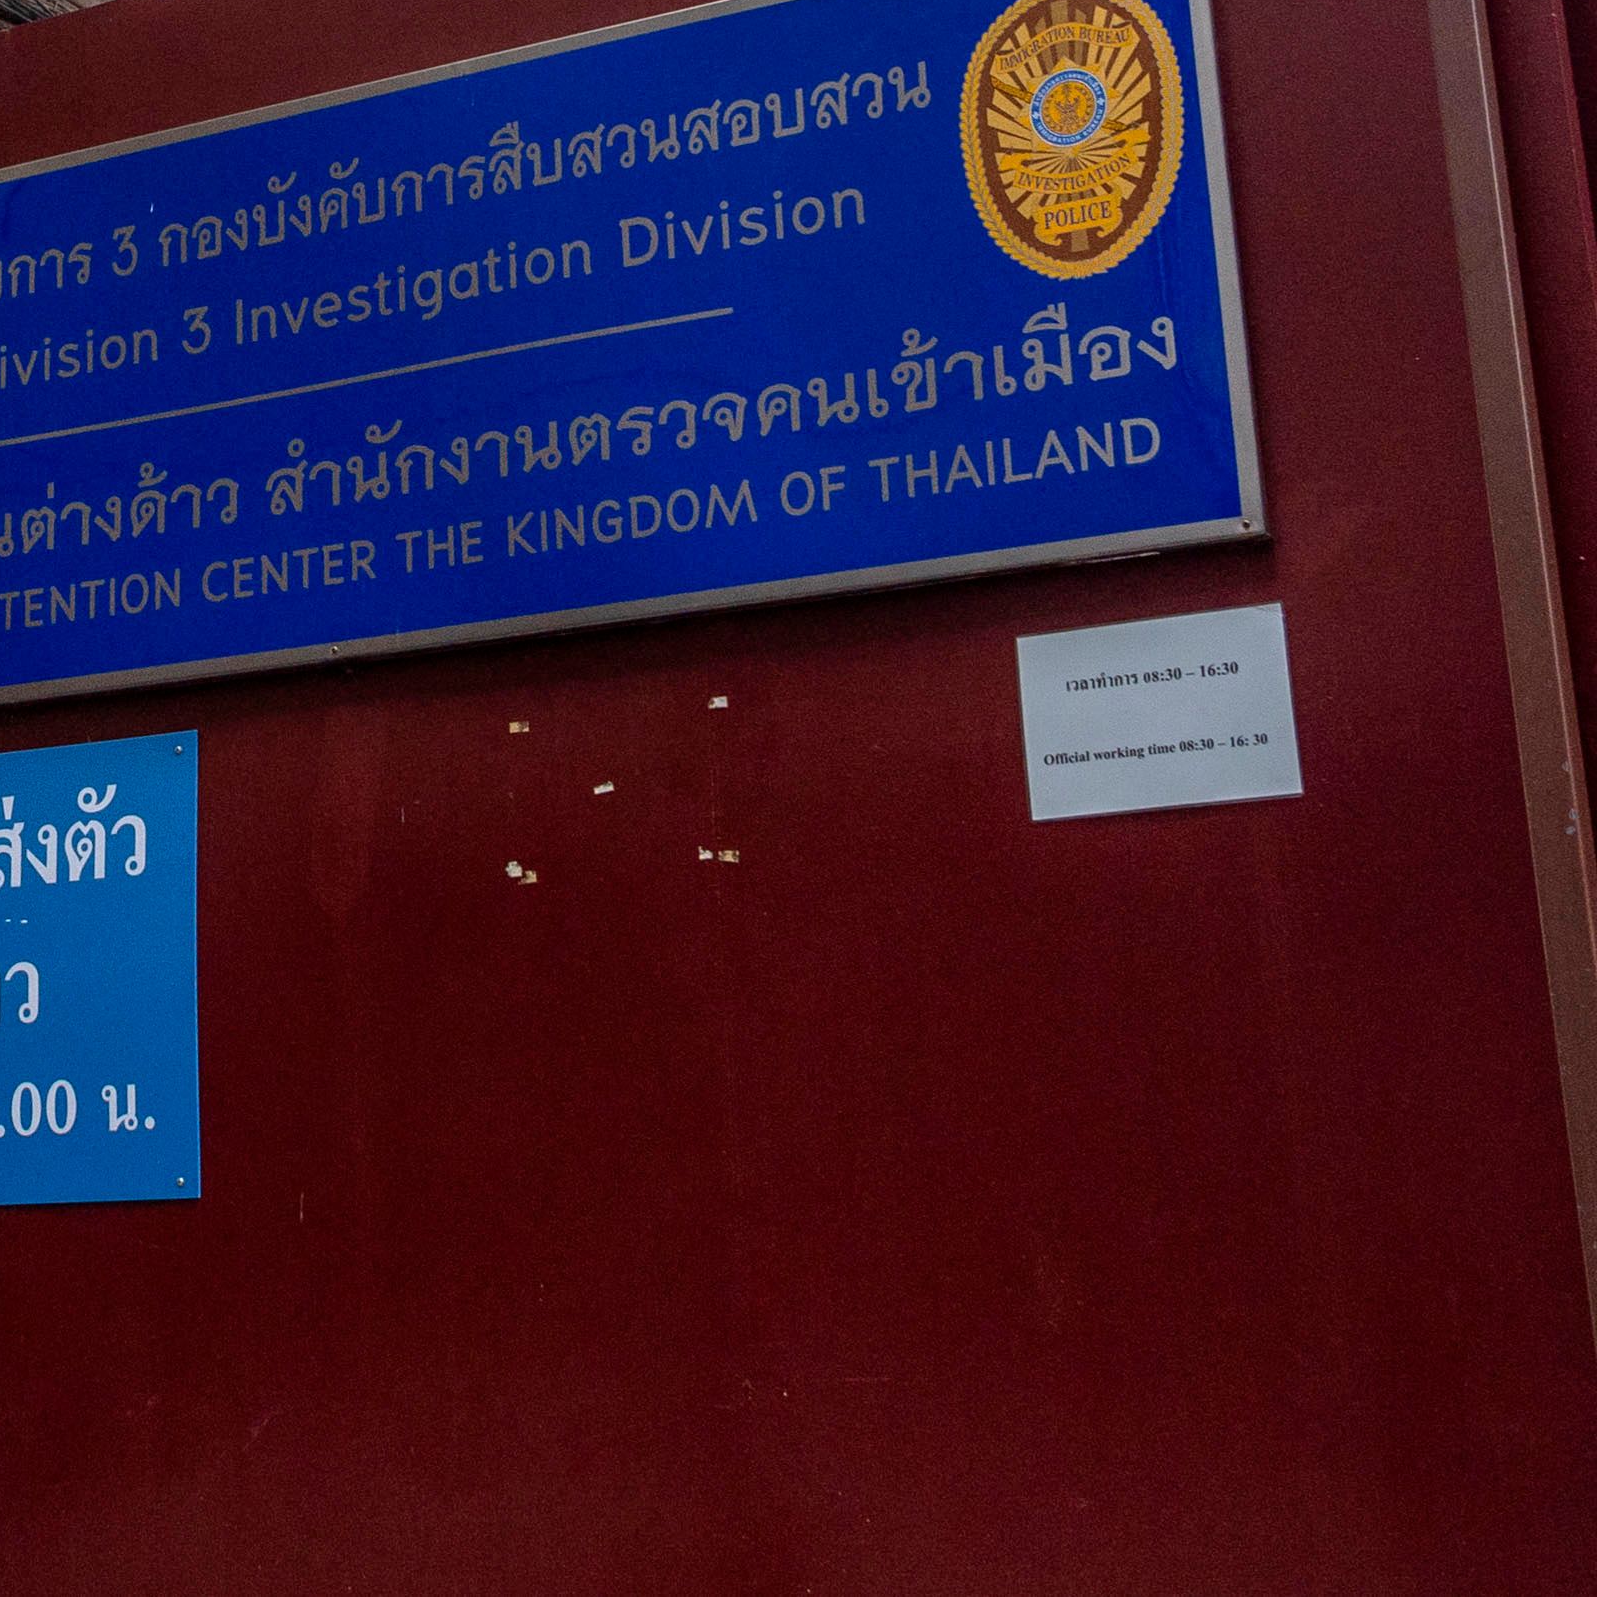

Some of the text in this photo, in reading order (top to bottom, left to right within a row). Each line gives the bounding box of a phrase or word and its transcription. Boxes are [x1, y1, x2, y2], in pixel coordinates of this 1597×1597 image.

[999, 25, 1132, 71] IMMIGRATION BUREAU
[111, 225, 139, 277] 3
[159, 61, 931, 268] กองบังคับการสืบสวนสอบสวน
[1017, 154, 1133, 189] INVESTIGATION
[1043, 200, 1112, 230] POLICE
[181, 306, 211, 355] 3
[235, 239, 592, 346] Investigation
[619, 187, 866, 268] Division
[266, 302, 1177, 516] สำนักงานตรวจคนเข้าเมือง
[202, 539, 377, 603] CENTER
[395, 520, 484, 573] THE
[507, 479, 758, 557] KINGDOM
[779, 464, 847, 516] OF
[867, 416, 1161, 503] THAILAND
[1065, 671, 1138, 692] เวลาทำการ
[1143, 667, 1182, 684] 08:30
[1200, 661, 1239, 678] 16:30
[1043, 751, 1090, 766] Official
[1093, 746, 1145, 762] working
[1148, 743, 1176, 755] time
[1179, 738, 1214, 752] 08:30
[101, 1083, 156, 1132] น.
